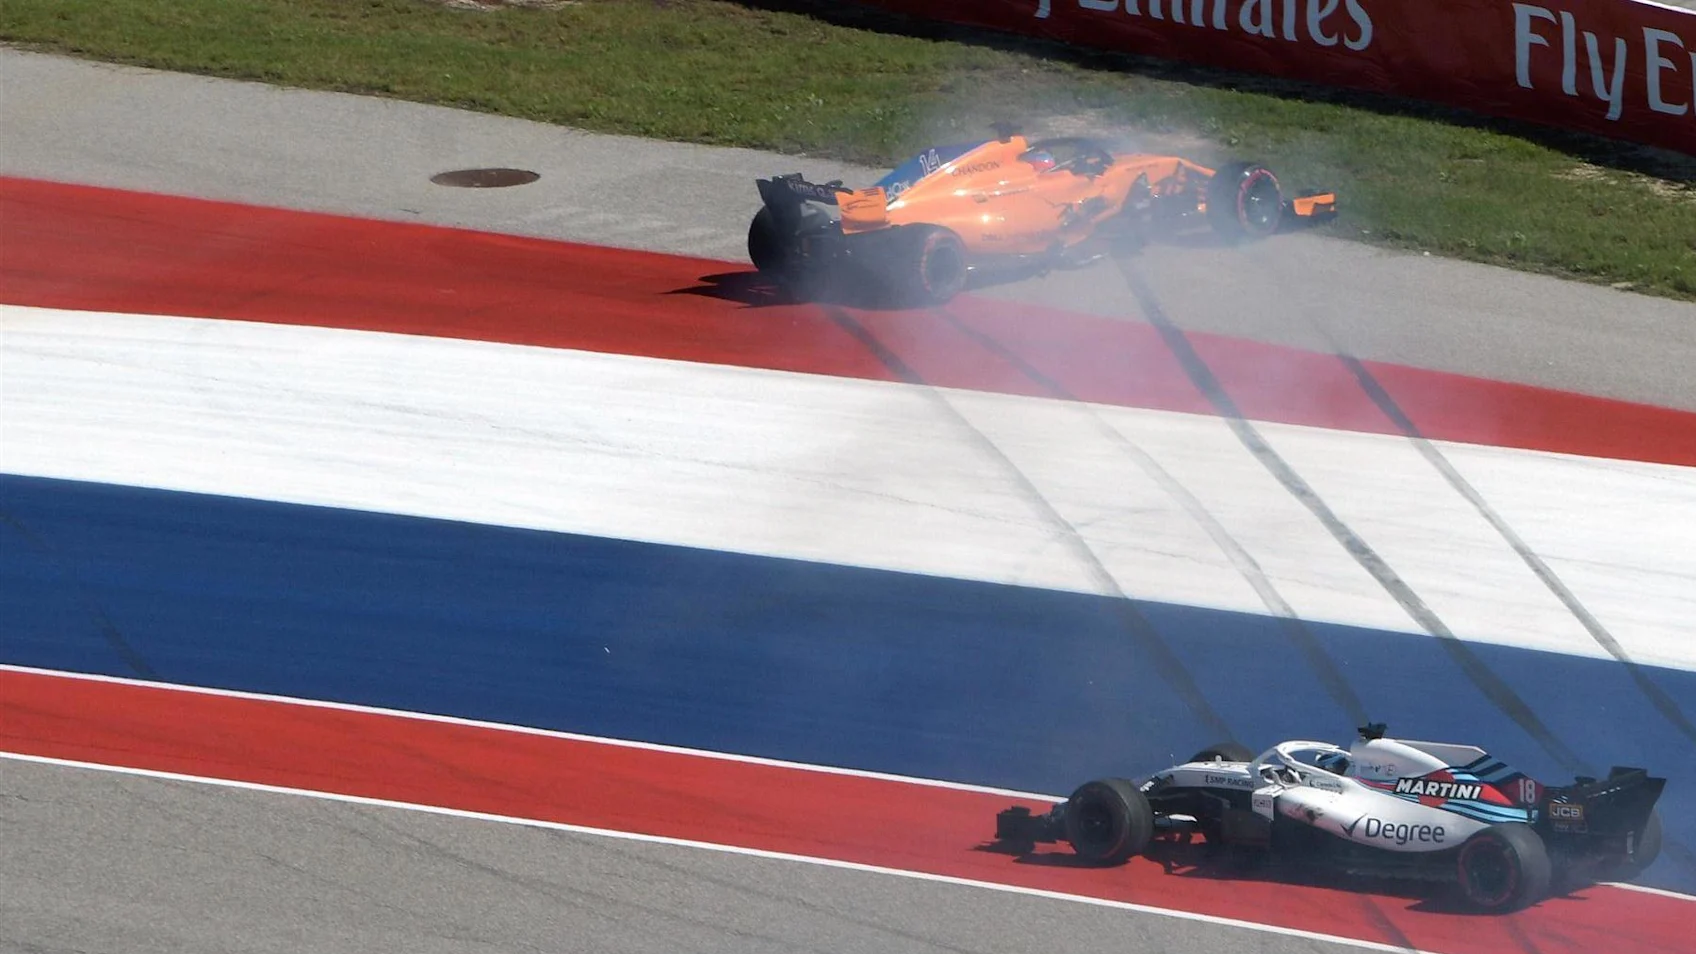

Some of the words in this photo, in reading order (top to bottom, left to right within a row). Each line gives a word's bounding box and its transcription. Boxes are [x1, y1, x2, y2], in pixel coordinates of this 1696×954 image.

[1513, 2, 1627, 119] Fly
[919, 148, 941, 175] 14
[951, 161, 1000, 177] CHANDON
[1395, 778, 1482, 800] MARTINI
[1518, 778, 1536, 802] 18
[1552, 806, 1580, 818] JCB
[1364, 817, 1445, 845] Degree
